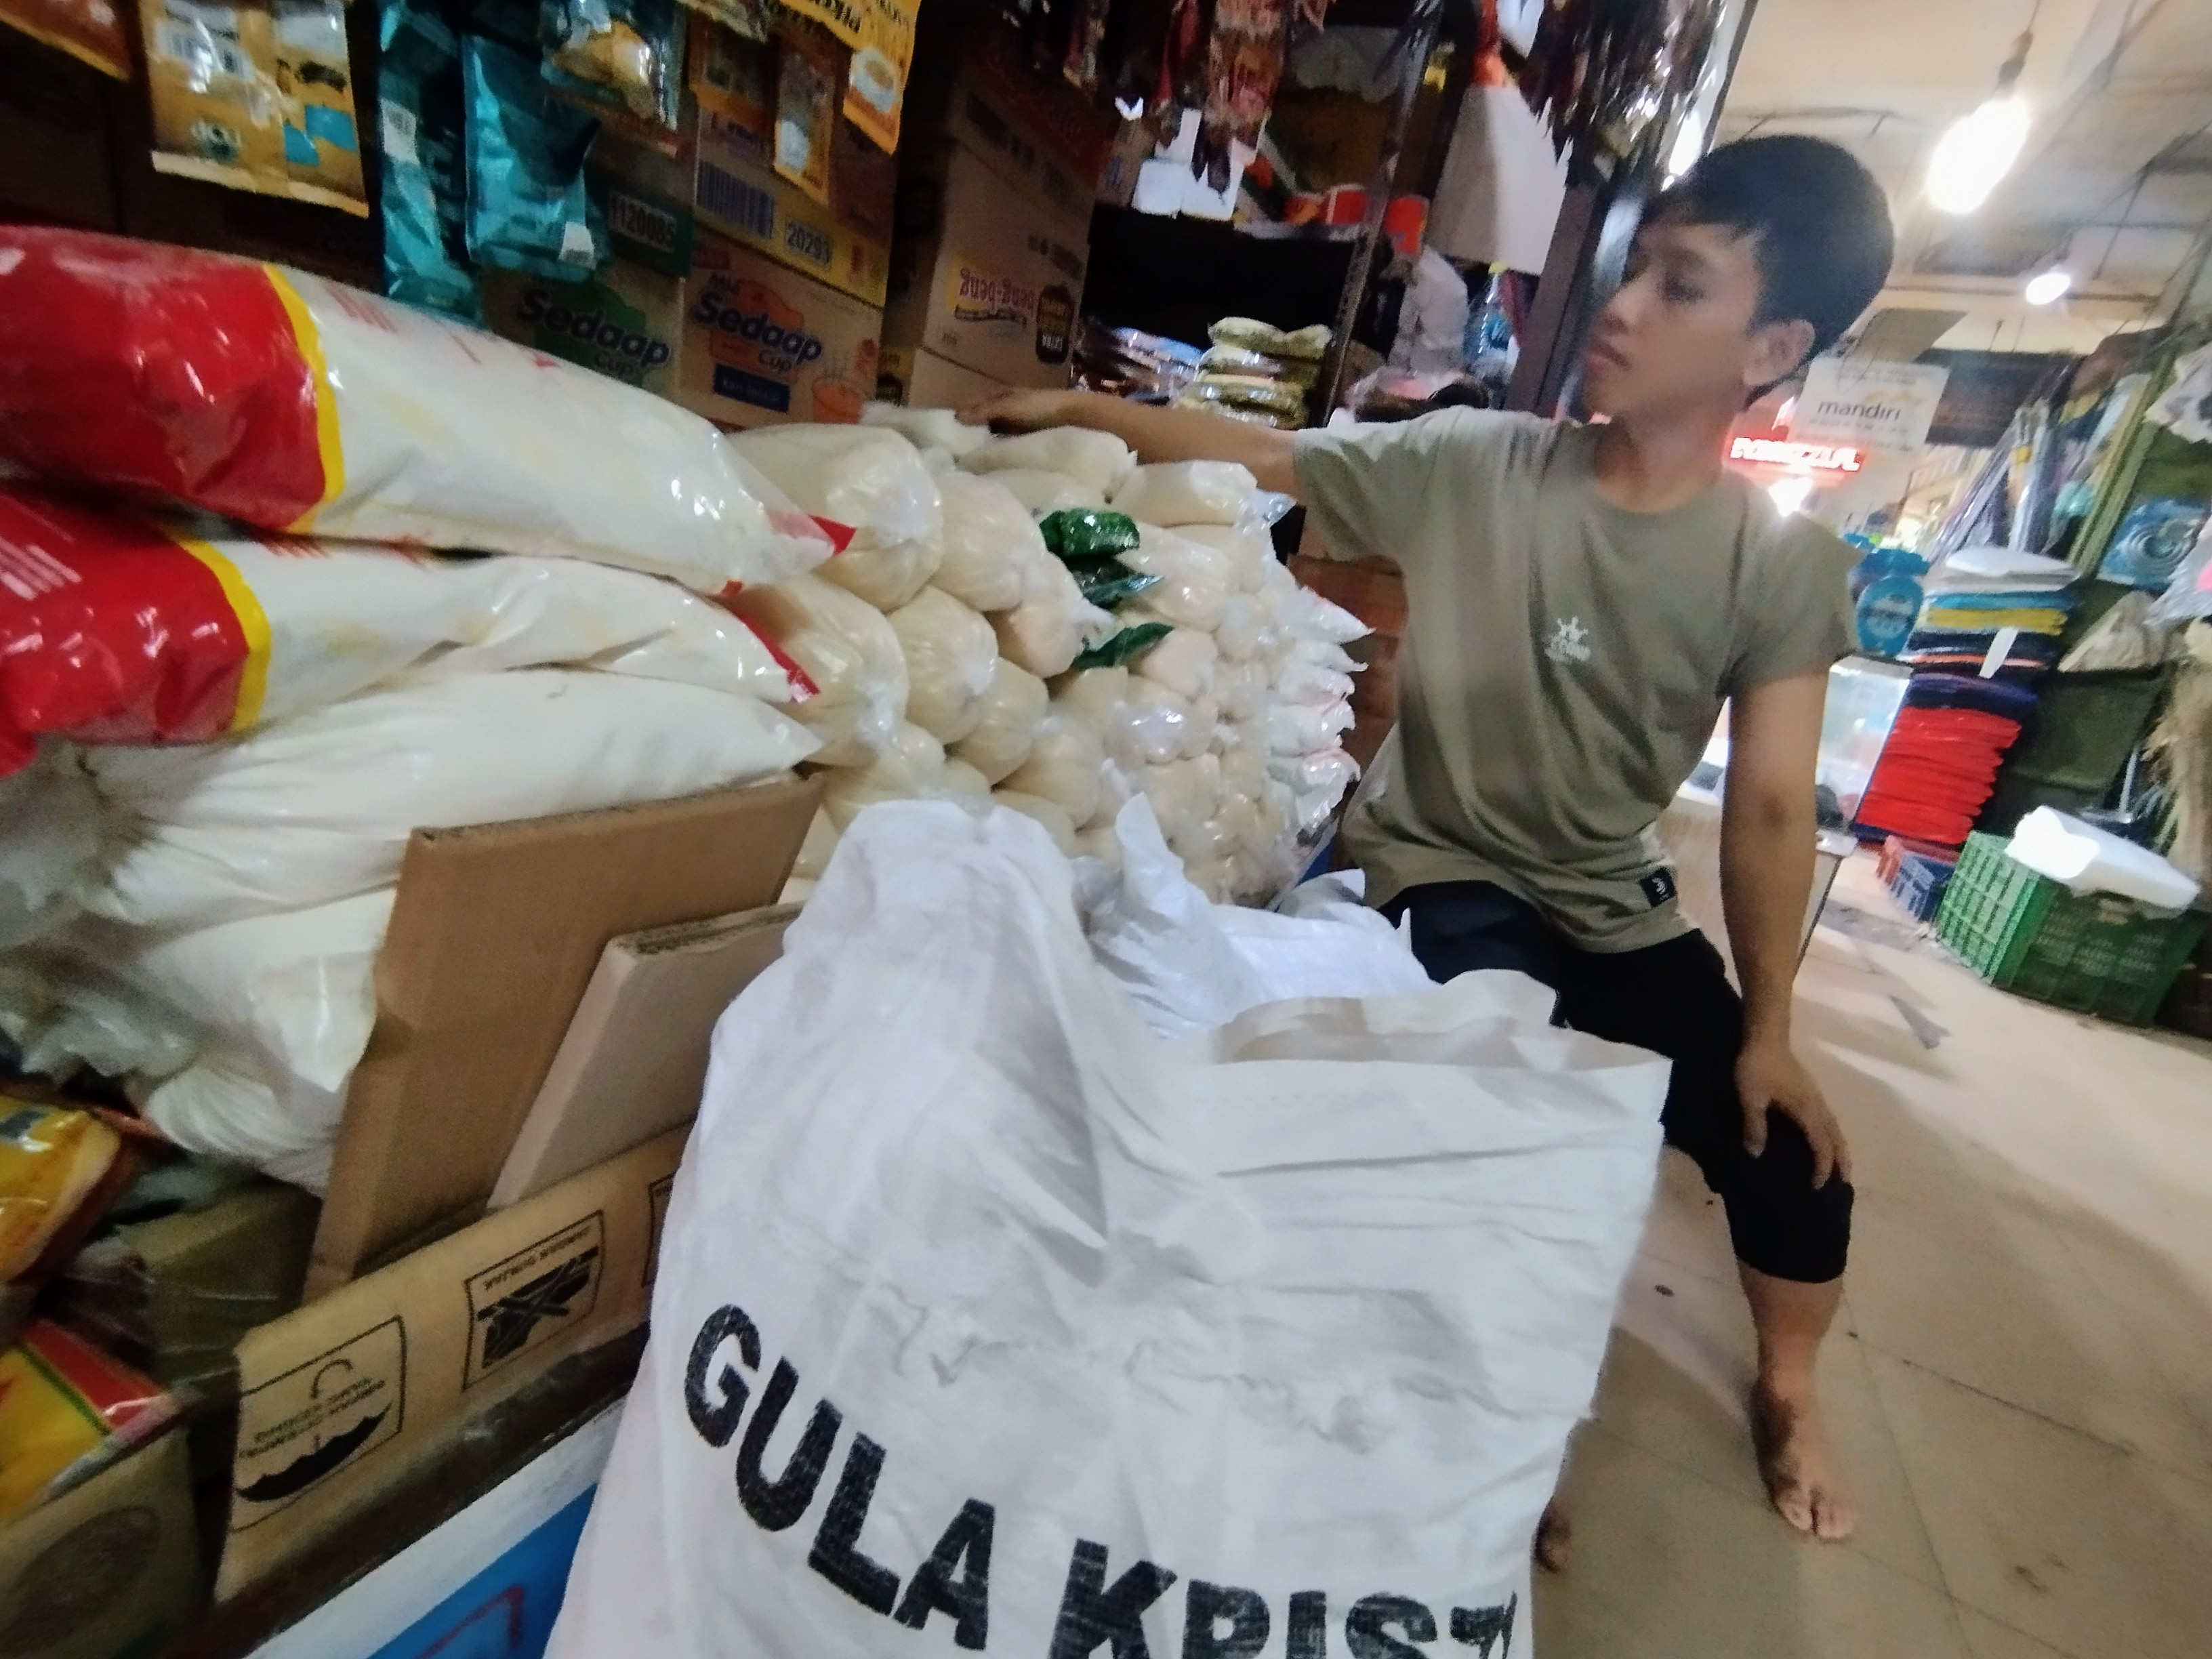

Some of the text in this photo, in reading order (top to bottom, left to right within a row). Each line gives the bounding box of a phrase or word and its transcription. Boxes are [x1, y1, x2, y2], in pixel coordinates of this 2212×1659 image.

[516, 288, 670, 367] Sedaap
[692, 288, 822, 366] Sedaap
[758, 349, 792, 372] Cup
[1816, 401, 1902, 422] mandiri
[683, 1303, 995, 1650] GULA
